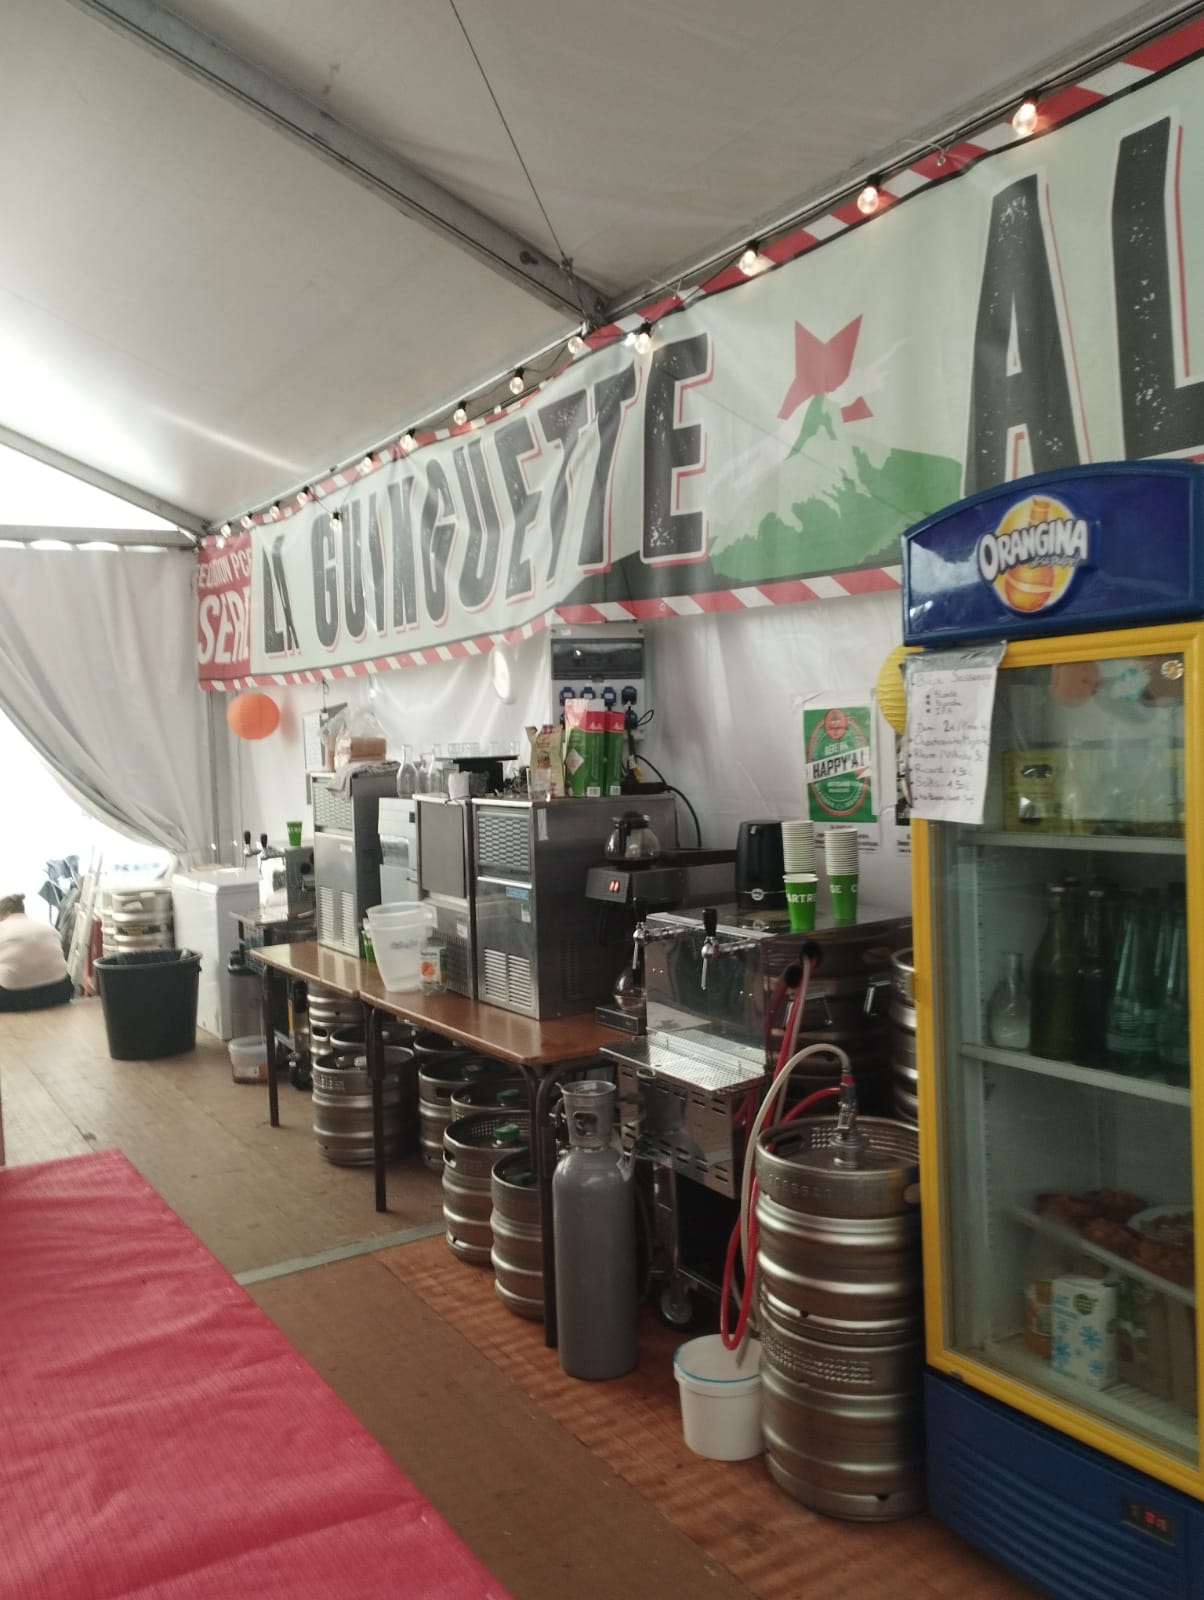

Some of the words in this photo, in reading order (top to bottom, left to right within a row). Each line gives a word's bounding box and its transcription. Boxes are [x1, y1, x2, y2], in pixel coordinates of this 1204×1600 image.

[263, 534, 300, 657] LA
[310, 333, 712, 651] GUINGUETTE
[978, 519, 1088, 582] ORANGINA
